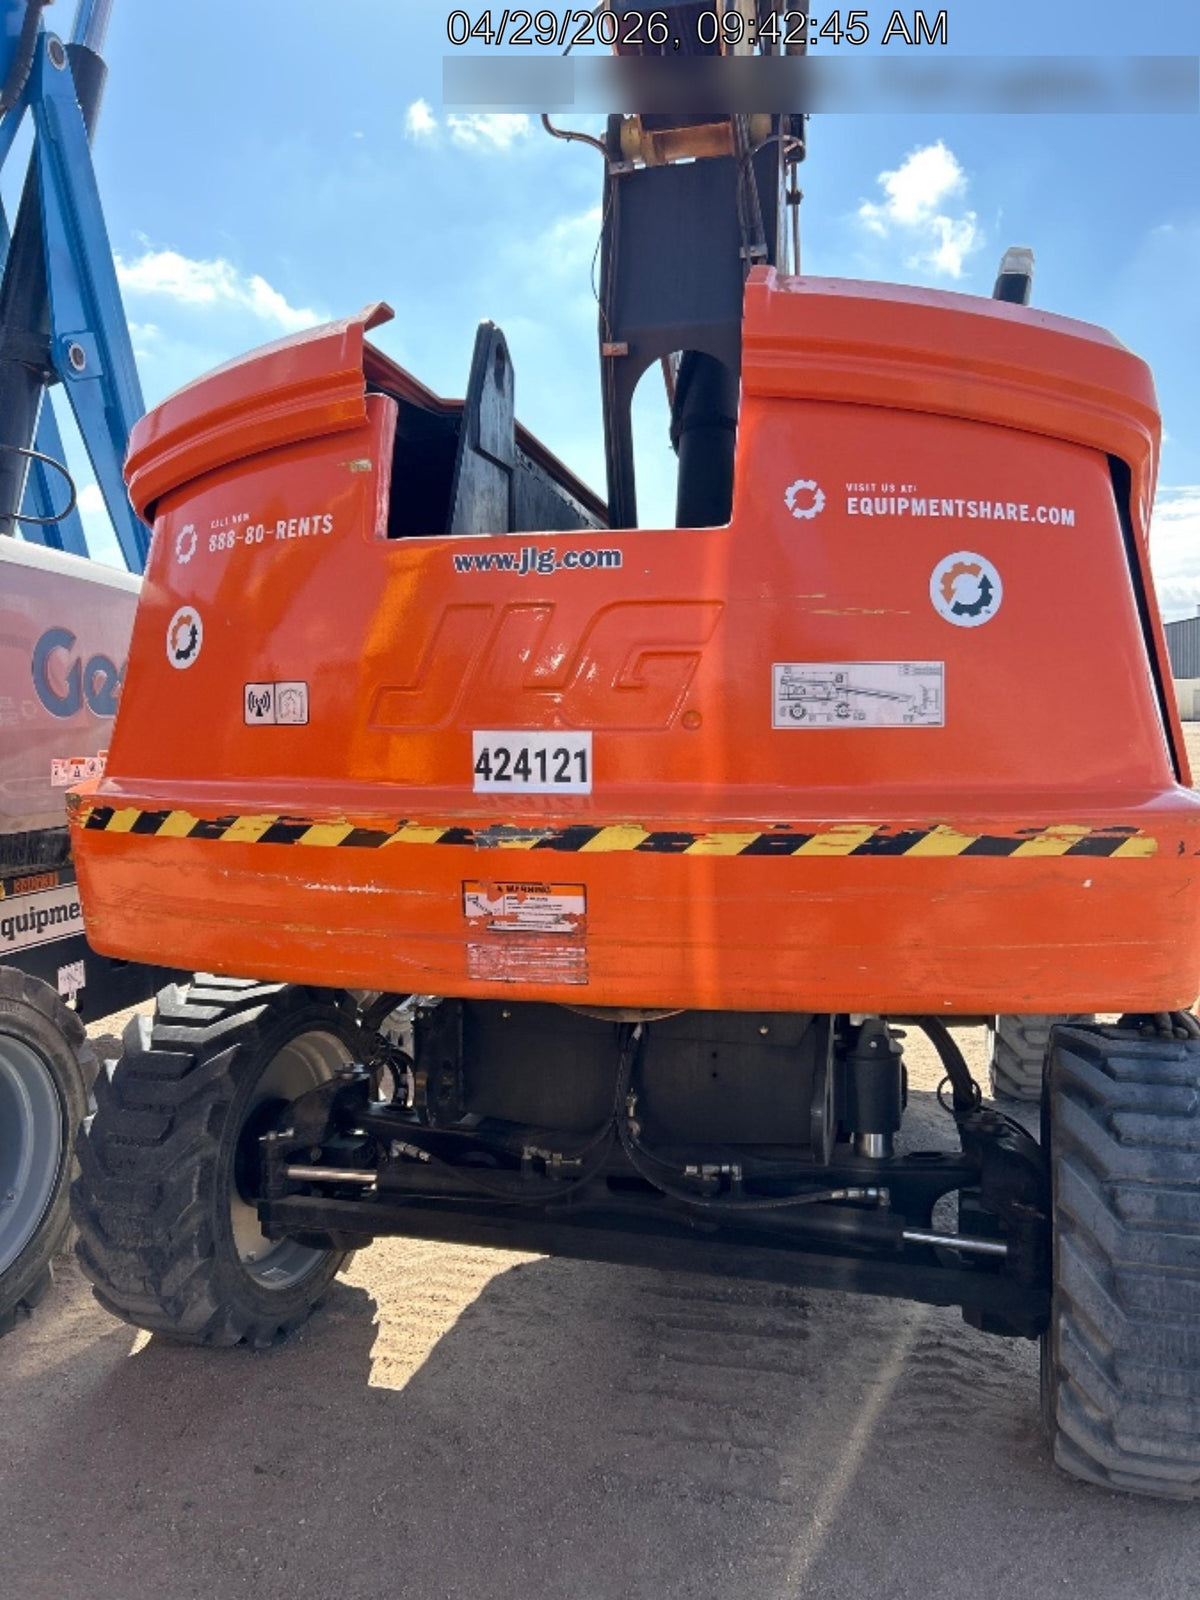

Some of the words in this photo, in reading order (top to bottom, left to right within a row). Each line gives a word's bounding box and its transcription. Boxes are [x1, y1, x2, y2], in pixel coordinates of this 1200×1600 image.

[845, 483, 876, 492] VISIT
[881, 483, 895, 493] US
[847, 497, 1075, 527] EQUIPMENTSHARE.COM
[209, 513, 333, 552] 888-80-RENTS
[453, 547, 622, 576] www.jlg.com
[31, 626, 126, 719] Ge
[368, 599, 725, 732] JLG
[474, 748, 587, 783] 424121
[0, 902, 82, 941] quipme
